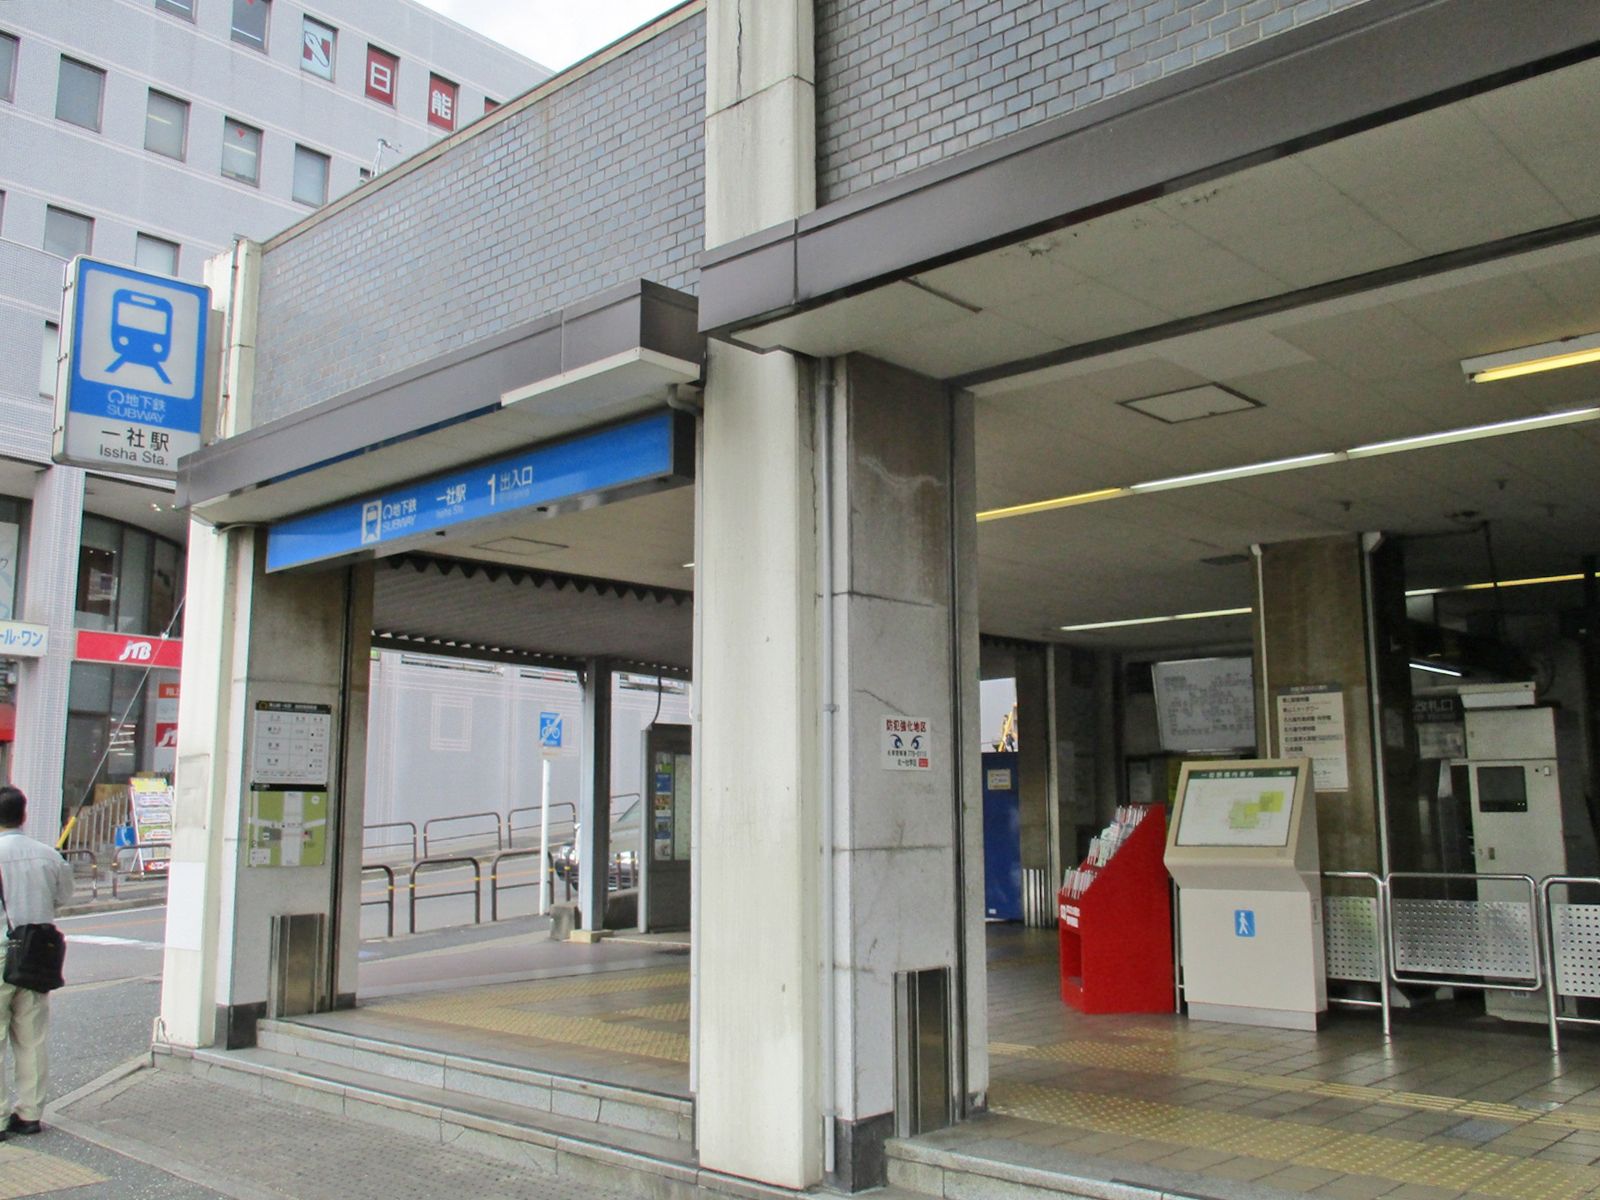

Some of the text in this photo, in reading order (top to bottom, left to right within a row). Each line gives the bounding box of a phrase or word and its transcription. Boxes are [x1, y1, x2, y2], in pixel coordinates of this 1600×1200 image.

[370, 61, 452, 121] 日 能
[107, 404, 166, 423] SUBWAY
[126, 393, 166, 412] 地下鉄
[101, 427, 169, 452] 一社駅
[100, 444, 169, 466] Issha Sta.
[391, 498, 416, 517] 地下鉄
[436, 484, 466, 506] 一社駅
[488, 473, 496, 506] 1
[500, 466, 533, 491] 出入口
[119, 641, 152, 661] JTB
